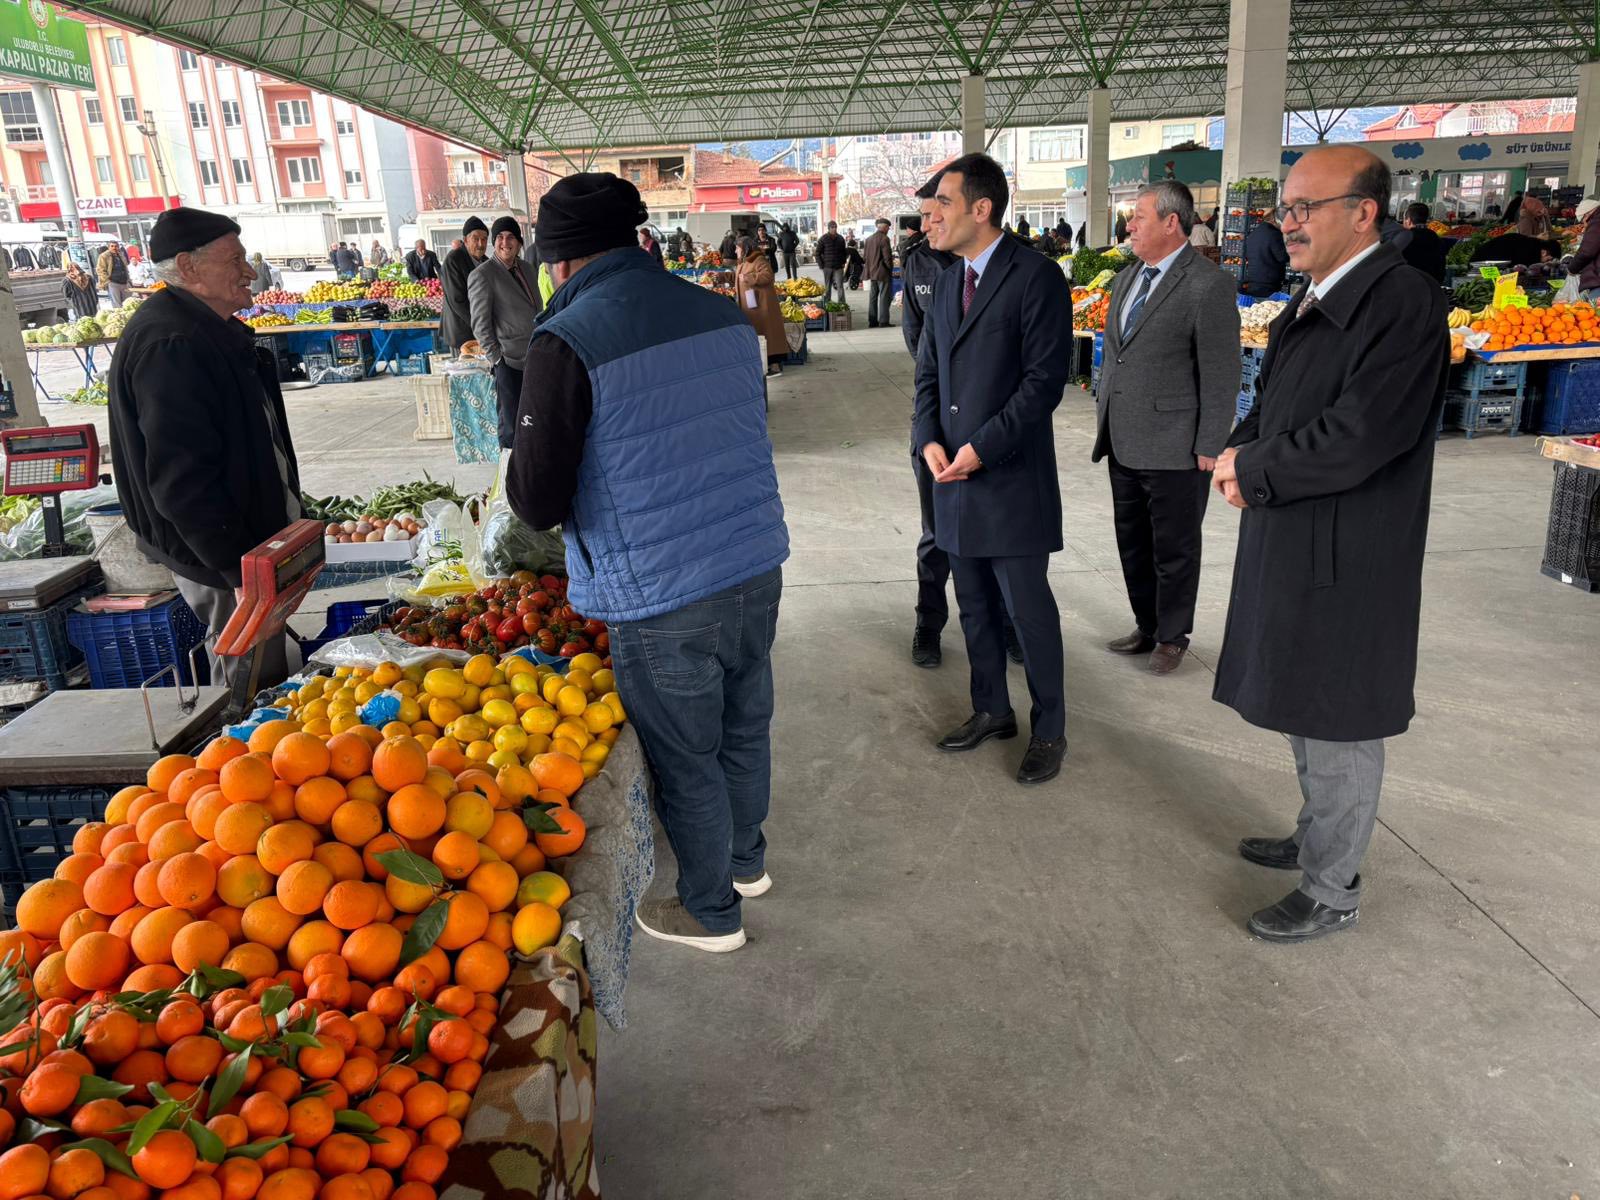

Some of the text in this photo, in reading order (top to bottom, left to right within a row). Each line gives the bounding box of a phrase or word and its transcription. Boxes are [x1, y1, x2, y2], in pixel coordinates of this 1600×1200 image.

[0, 48, 93, 83] KAPALI PAZAR YERİ
[1505, 143, 1528, 154] SÜT
[760, 187, 802, 198] Polisan
